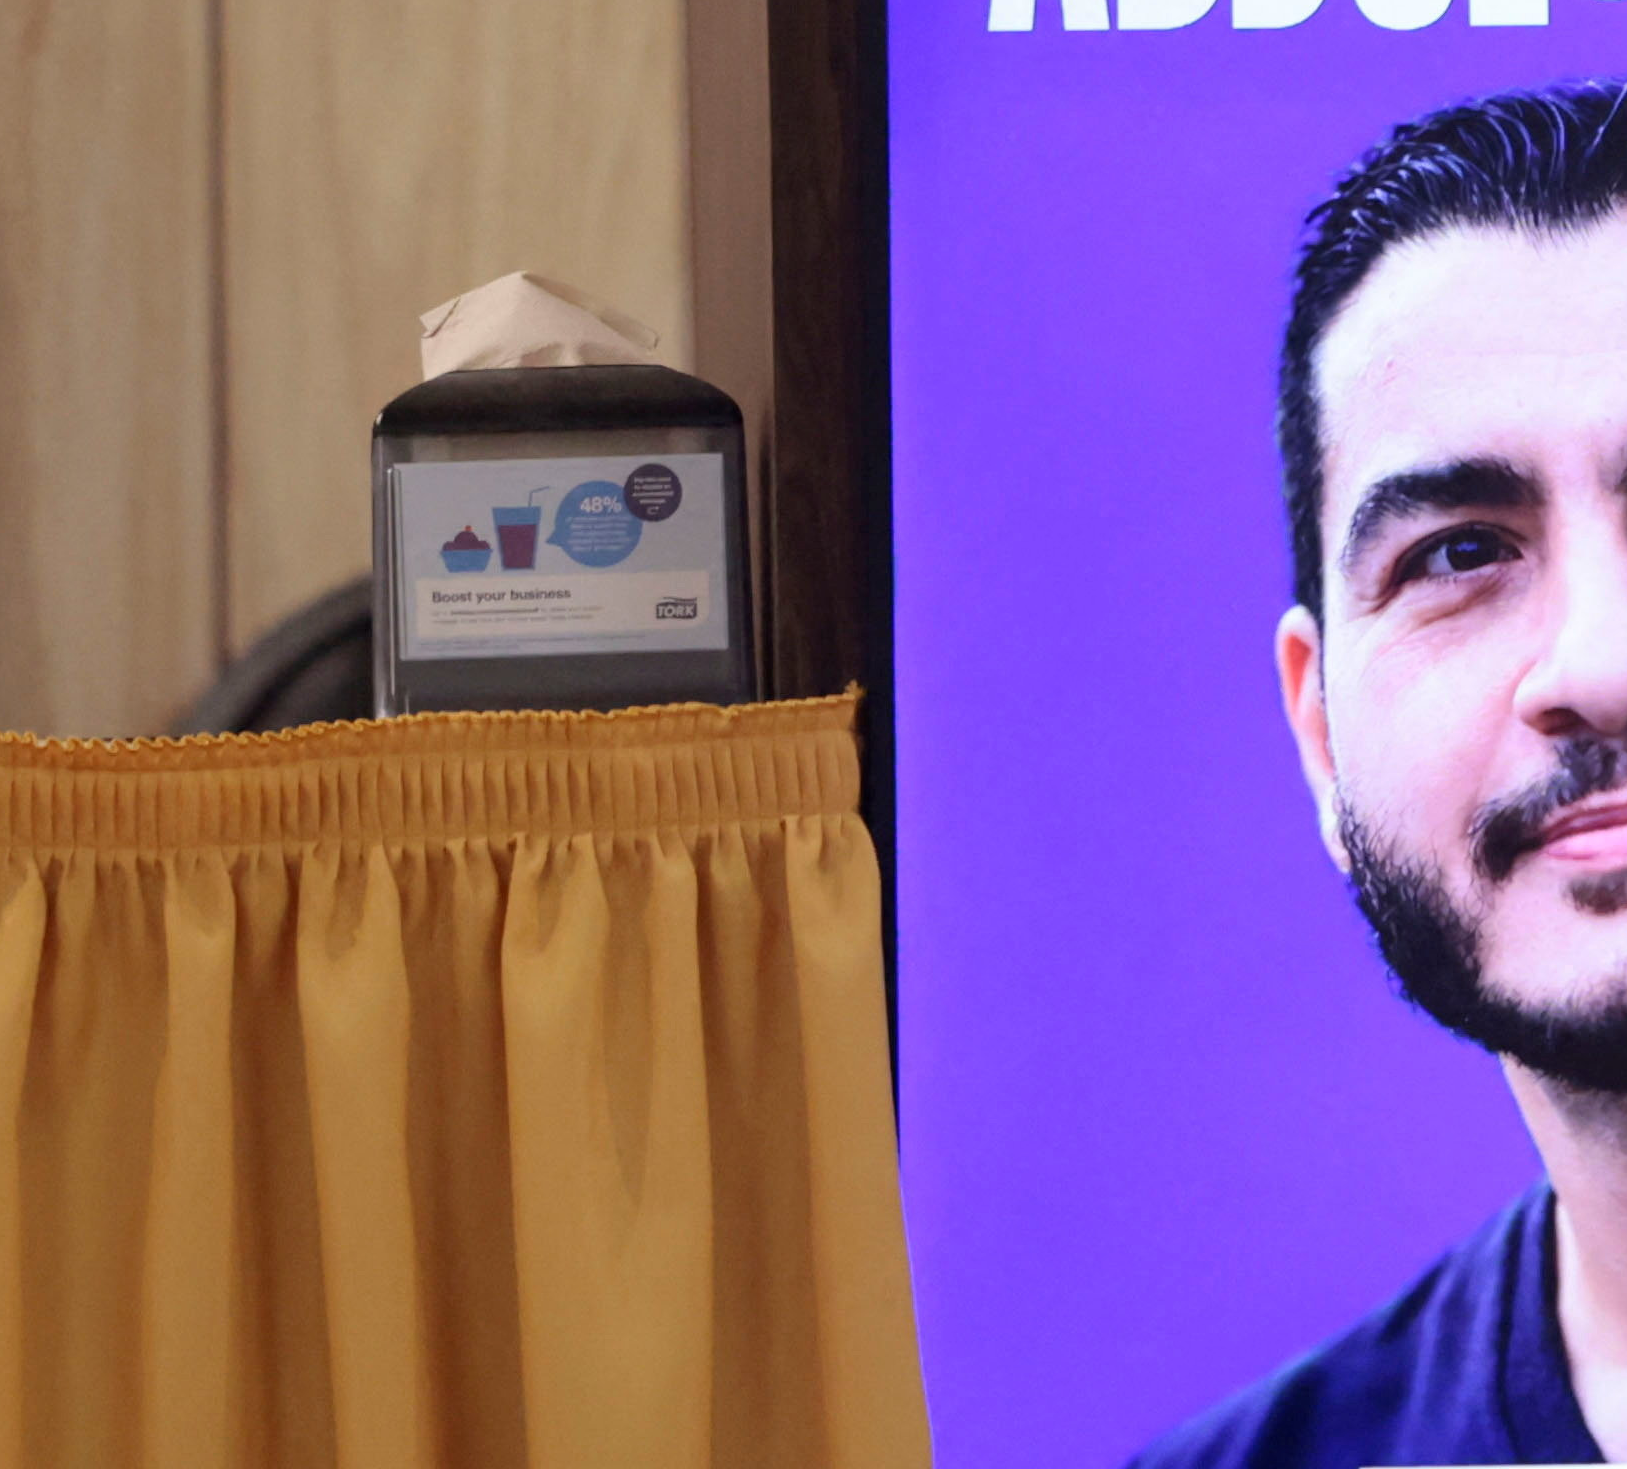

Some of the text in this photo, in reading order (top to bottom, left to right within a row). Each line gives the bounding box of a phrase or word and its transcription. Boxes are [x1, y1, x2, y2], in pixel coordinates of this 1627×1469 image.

[580, 495, 622, 514] 48%
[432, 589, 572, 605] Boost your business
[657, 603, 695, 618] TORK
